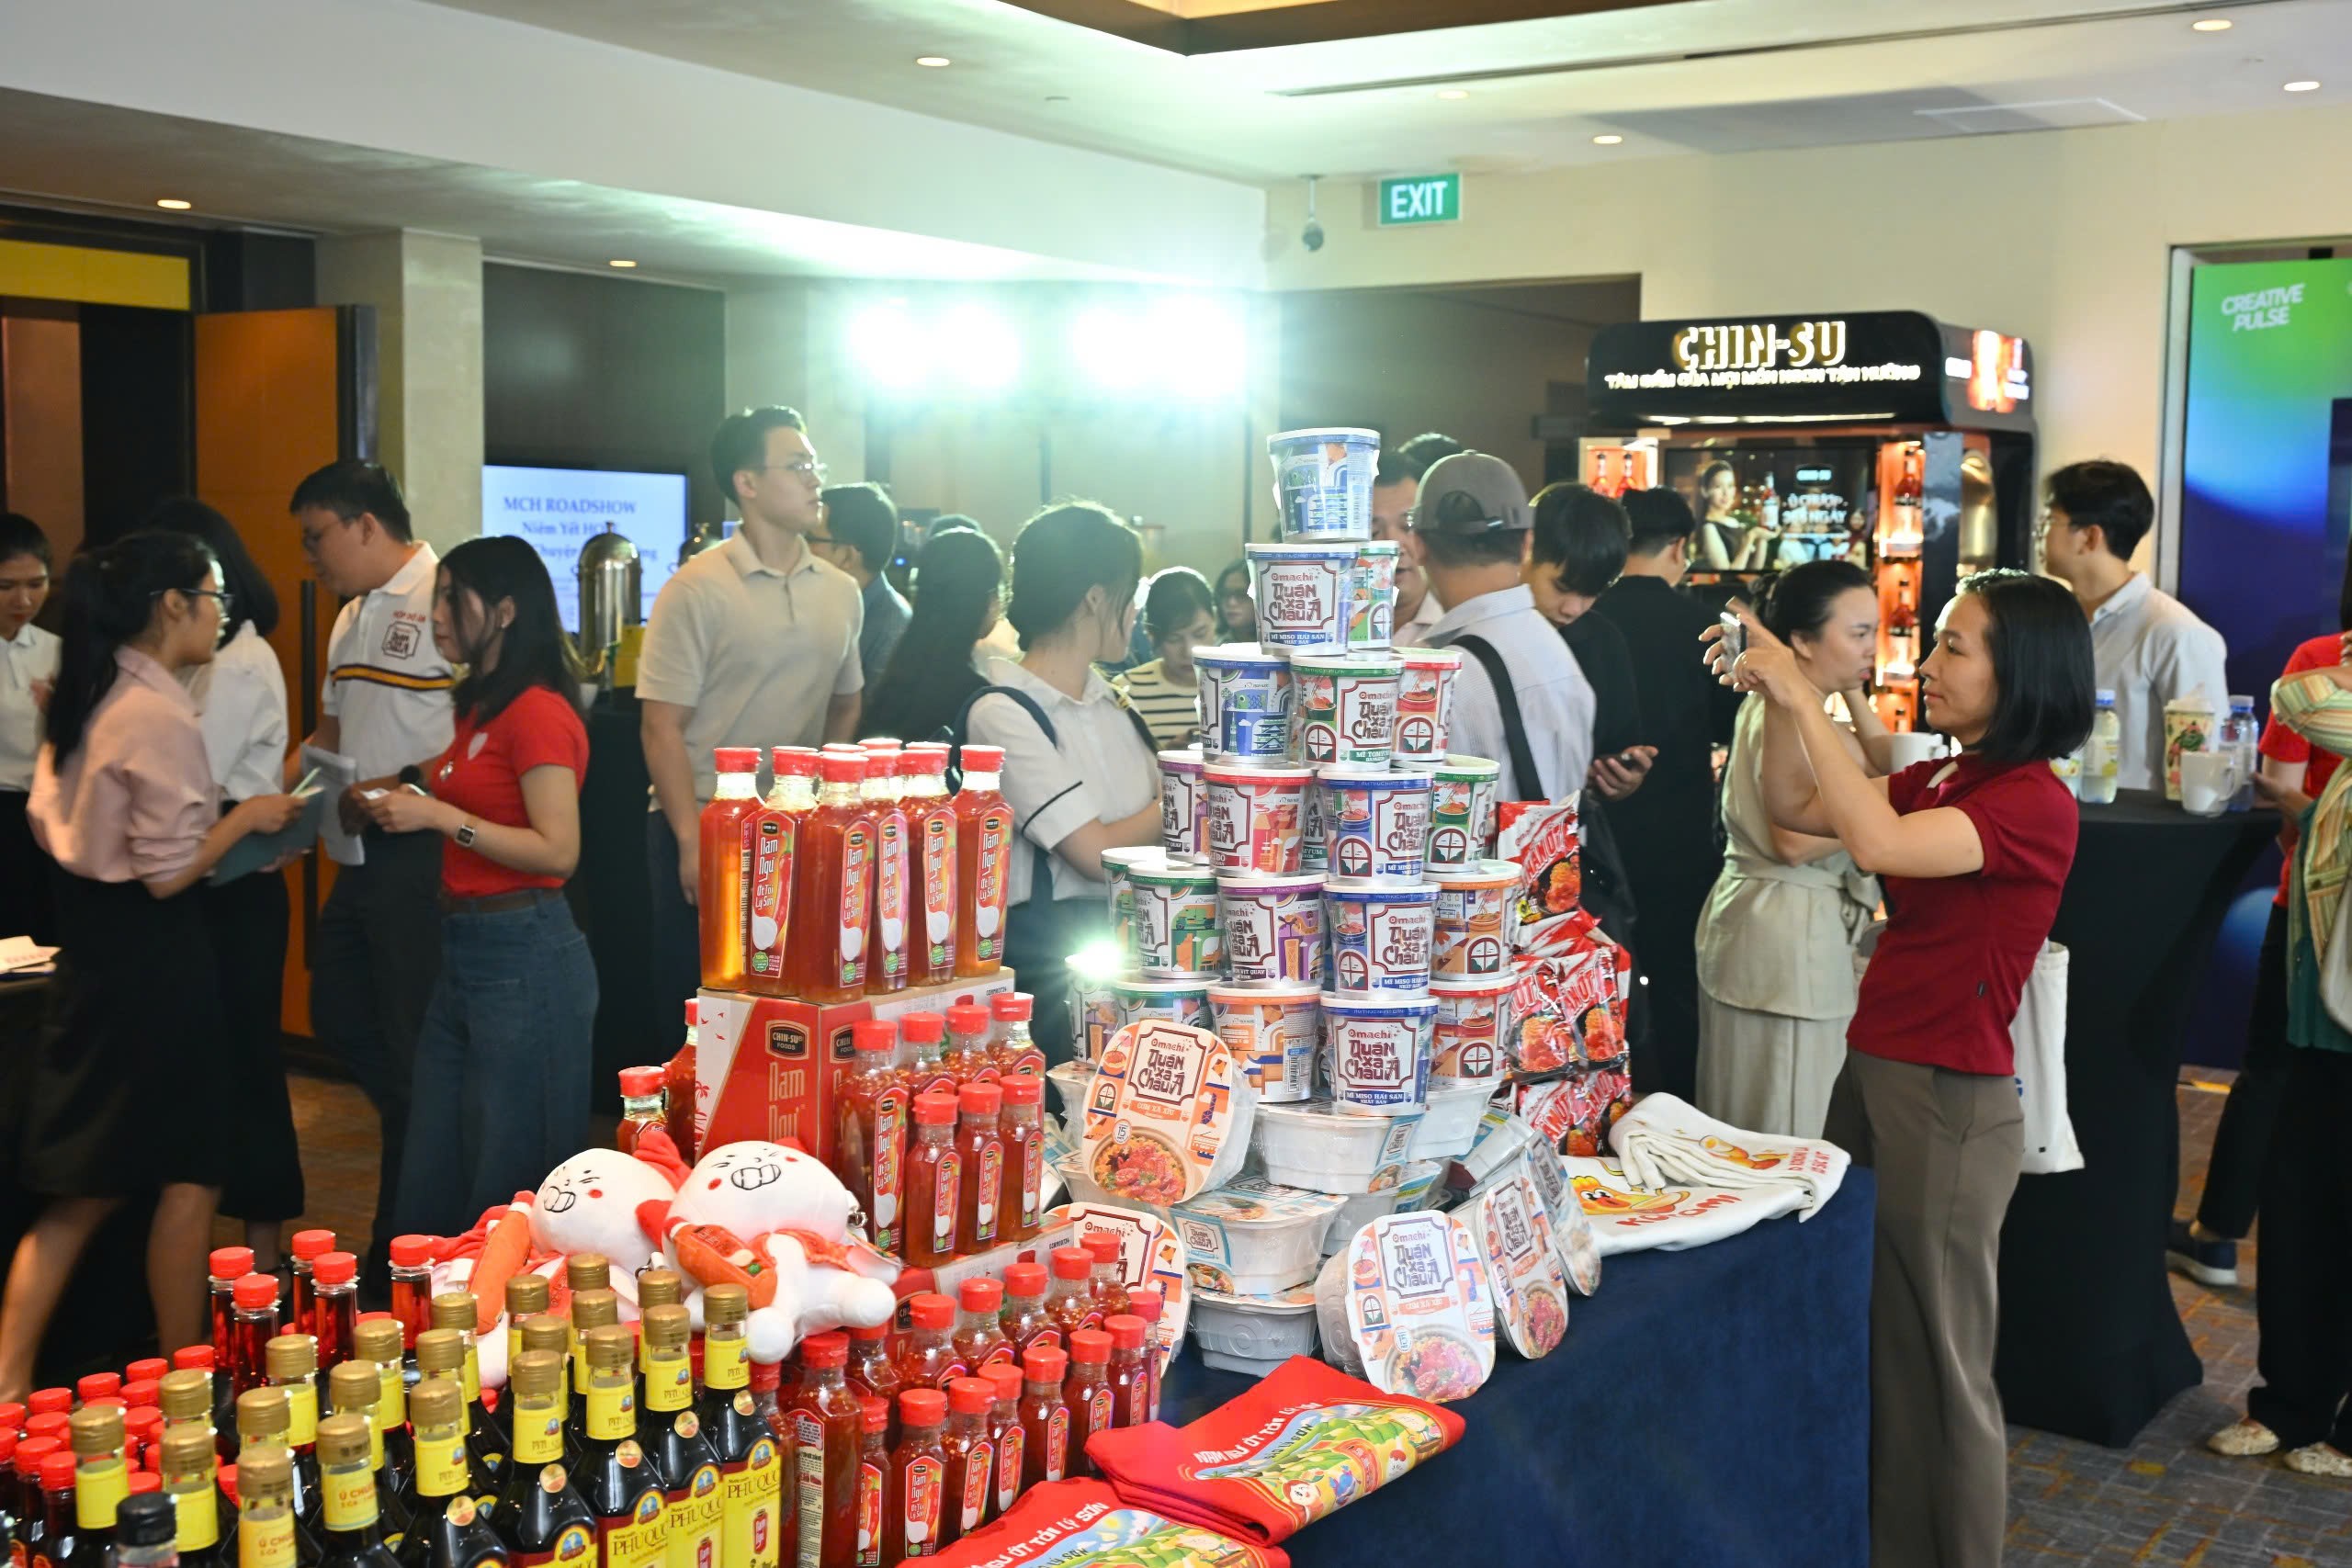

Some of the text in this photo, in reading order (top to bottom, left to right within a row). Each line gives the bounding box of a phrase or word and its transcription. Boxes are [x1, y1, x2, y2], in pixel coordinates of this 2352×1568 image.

[1391, 181, 1449, 220] EXIT
[2222, 282, 2306, 316] CREATIVE
[2233, 306, 2290, 333] PULSE
[1673, 321, 1846, 369] CHIN-SU
[503, 497, 637, 513] MCH ROADSHOW
[1271, 572, 1314, 582] Omachi
[760, 837, 778, 855] Nam
[772, 1032, 798, 1044] CHIN-SU
[1348, 1029, 1391, 1039] Omachi
[776, 1043, 797, 1051] FOODS
[1150, 1038, 1185, 1053] Omachi
[769, 1061, 806, 1102] Nam
[1355, 1092, 1373, 1100] MISO
[1392, 1232, 1426, 1243] Omachi
[1193, 1450, 1228, 1464] NAM
[1007, 1542, 1035, 1557] ỚT
[1028, 1527, 1062, 1546] TỎI
[1056, 1517, 1081, 1530] LÝ
[1074, 1502, 1110, 1522] SƠN
[1061, 1547, 1089, 1561] SƠN
